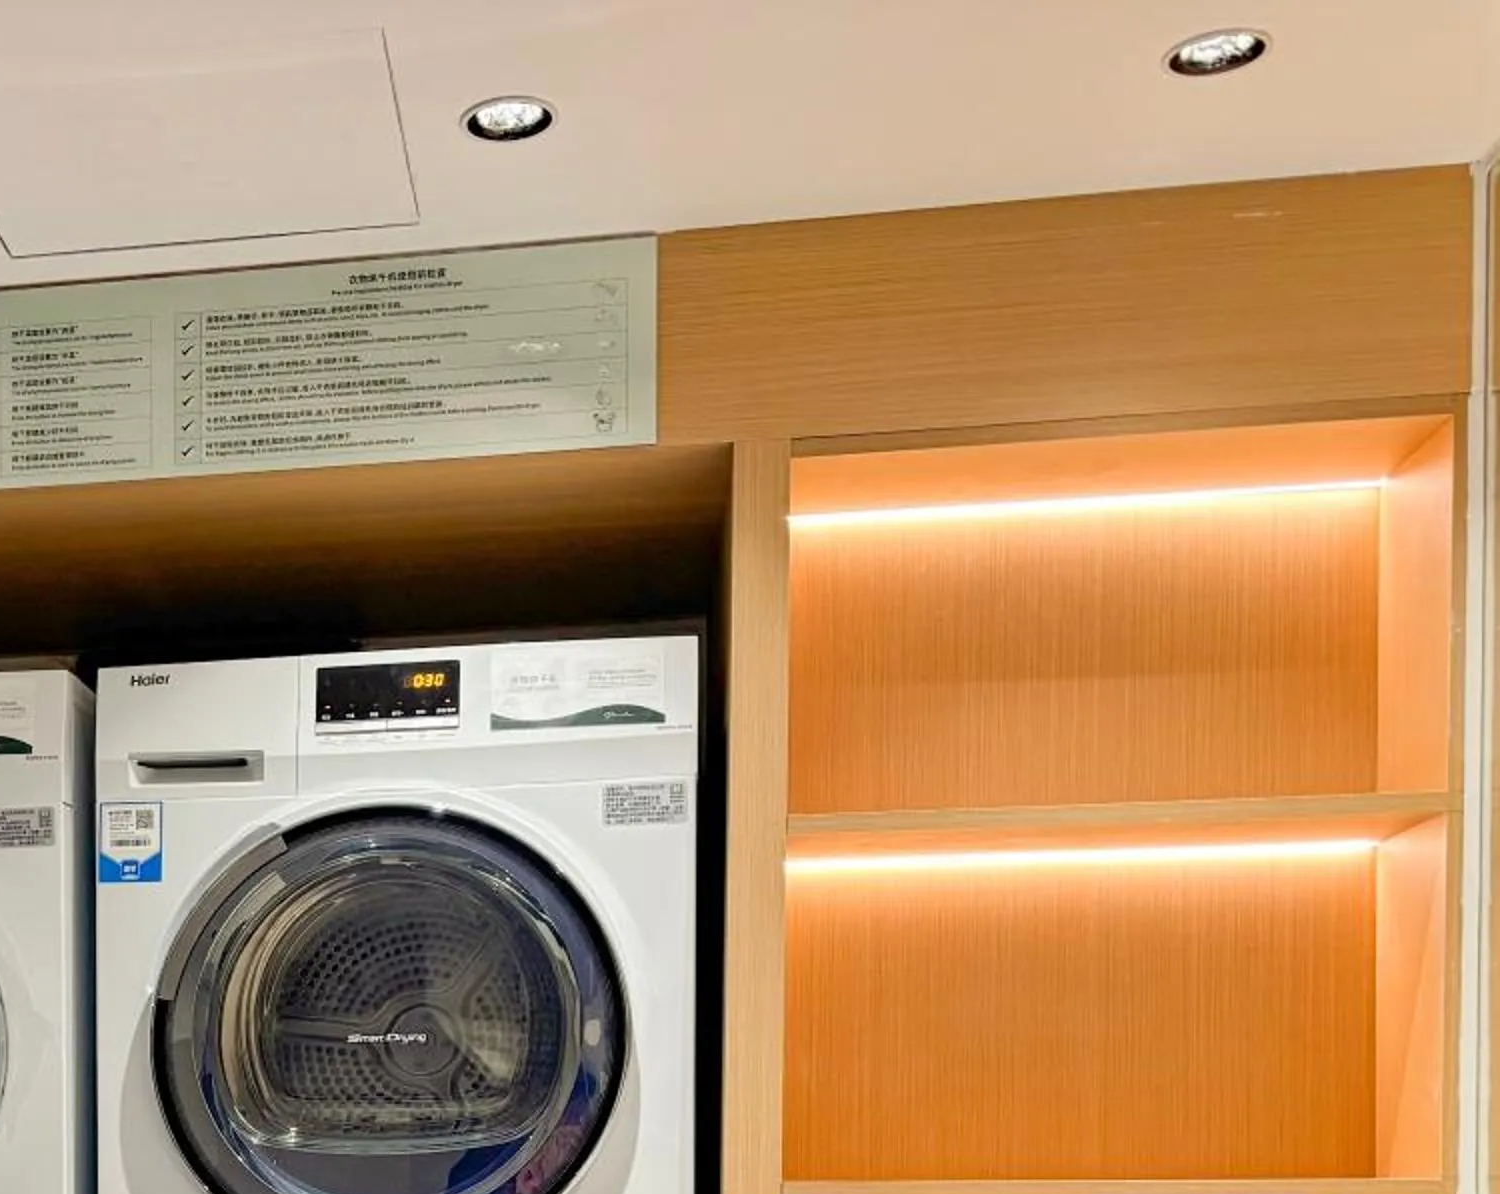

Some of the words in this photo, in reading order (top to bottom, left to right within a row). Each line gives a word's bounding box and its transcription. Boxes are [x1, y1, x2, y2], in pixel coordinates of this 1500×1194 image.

[130, 673, 170, 687] Haier
[347, 1033, 384, 1043] Smart
[386, 1033, 427, 1045] Drying
